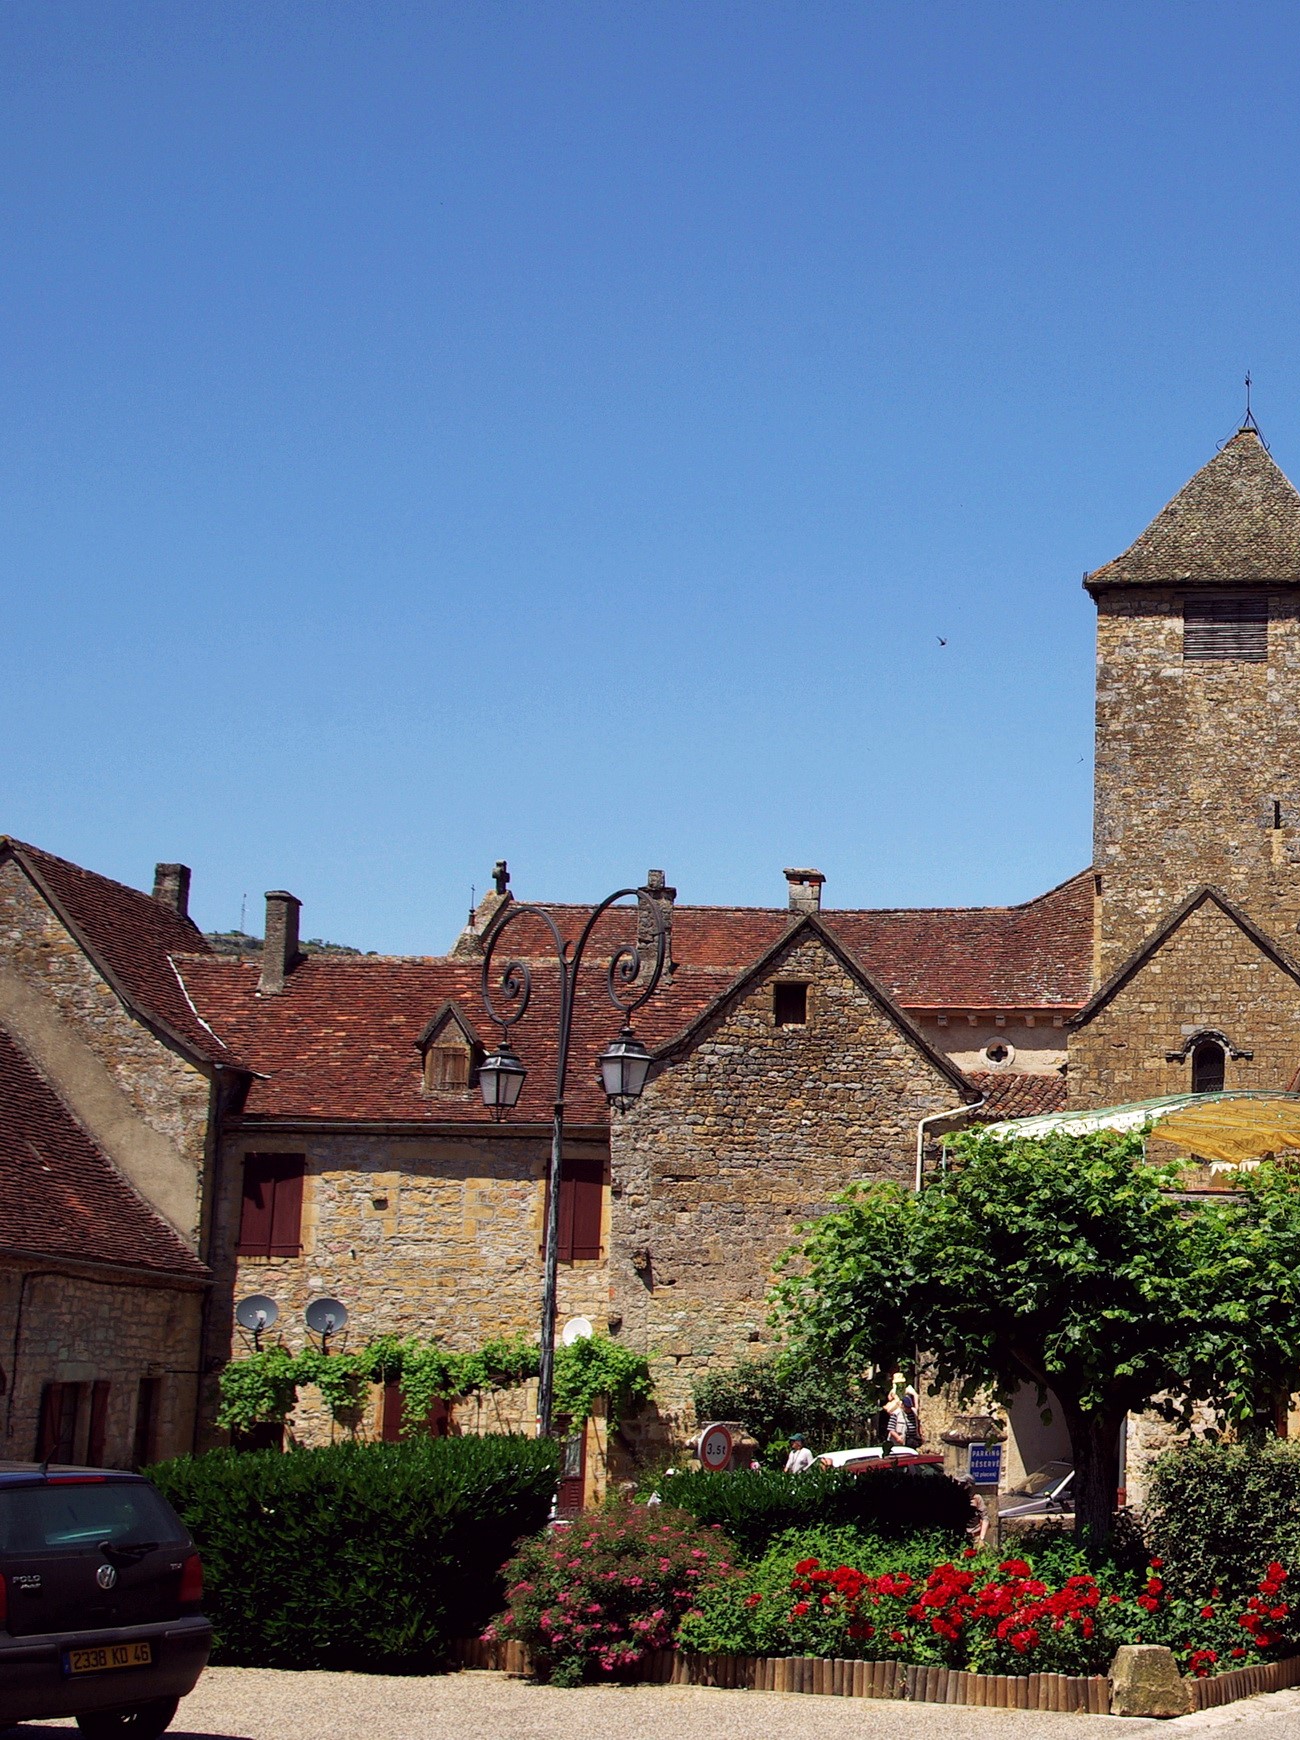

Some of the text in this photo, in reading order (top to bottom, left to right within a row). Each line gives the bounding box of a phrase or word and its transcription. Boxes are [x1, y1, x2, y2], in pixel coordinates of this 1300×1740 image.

[12, 1575, 41, 1583] POLO
[73, 1645, 149, 1670] 2338 KD 46
